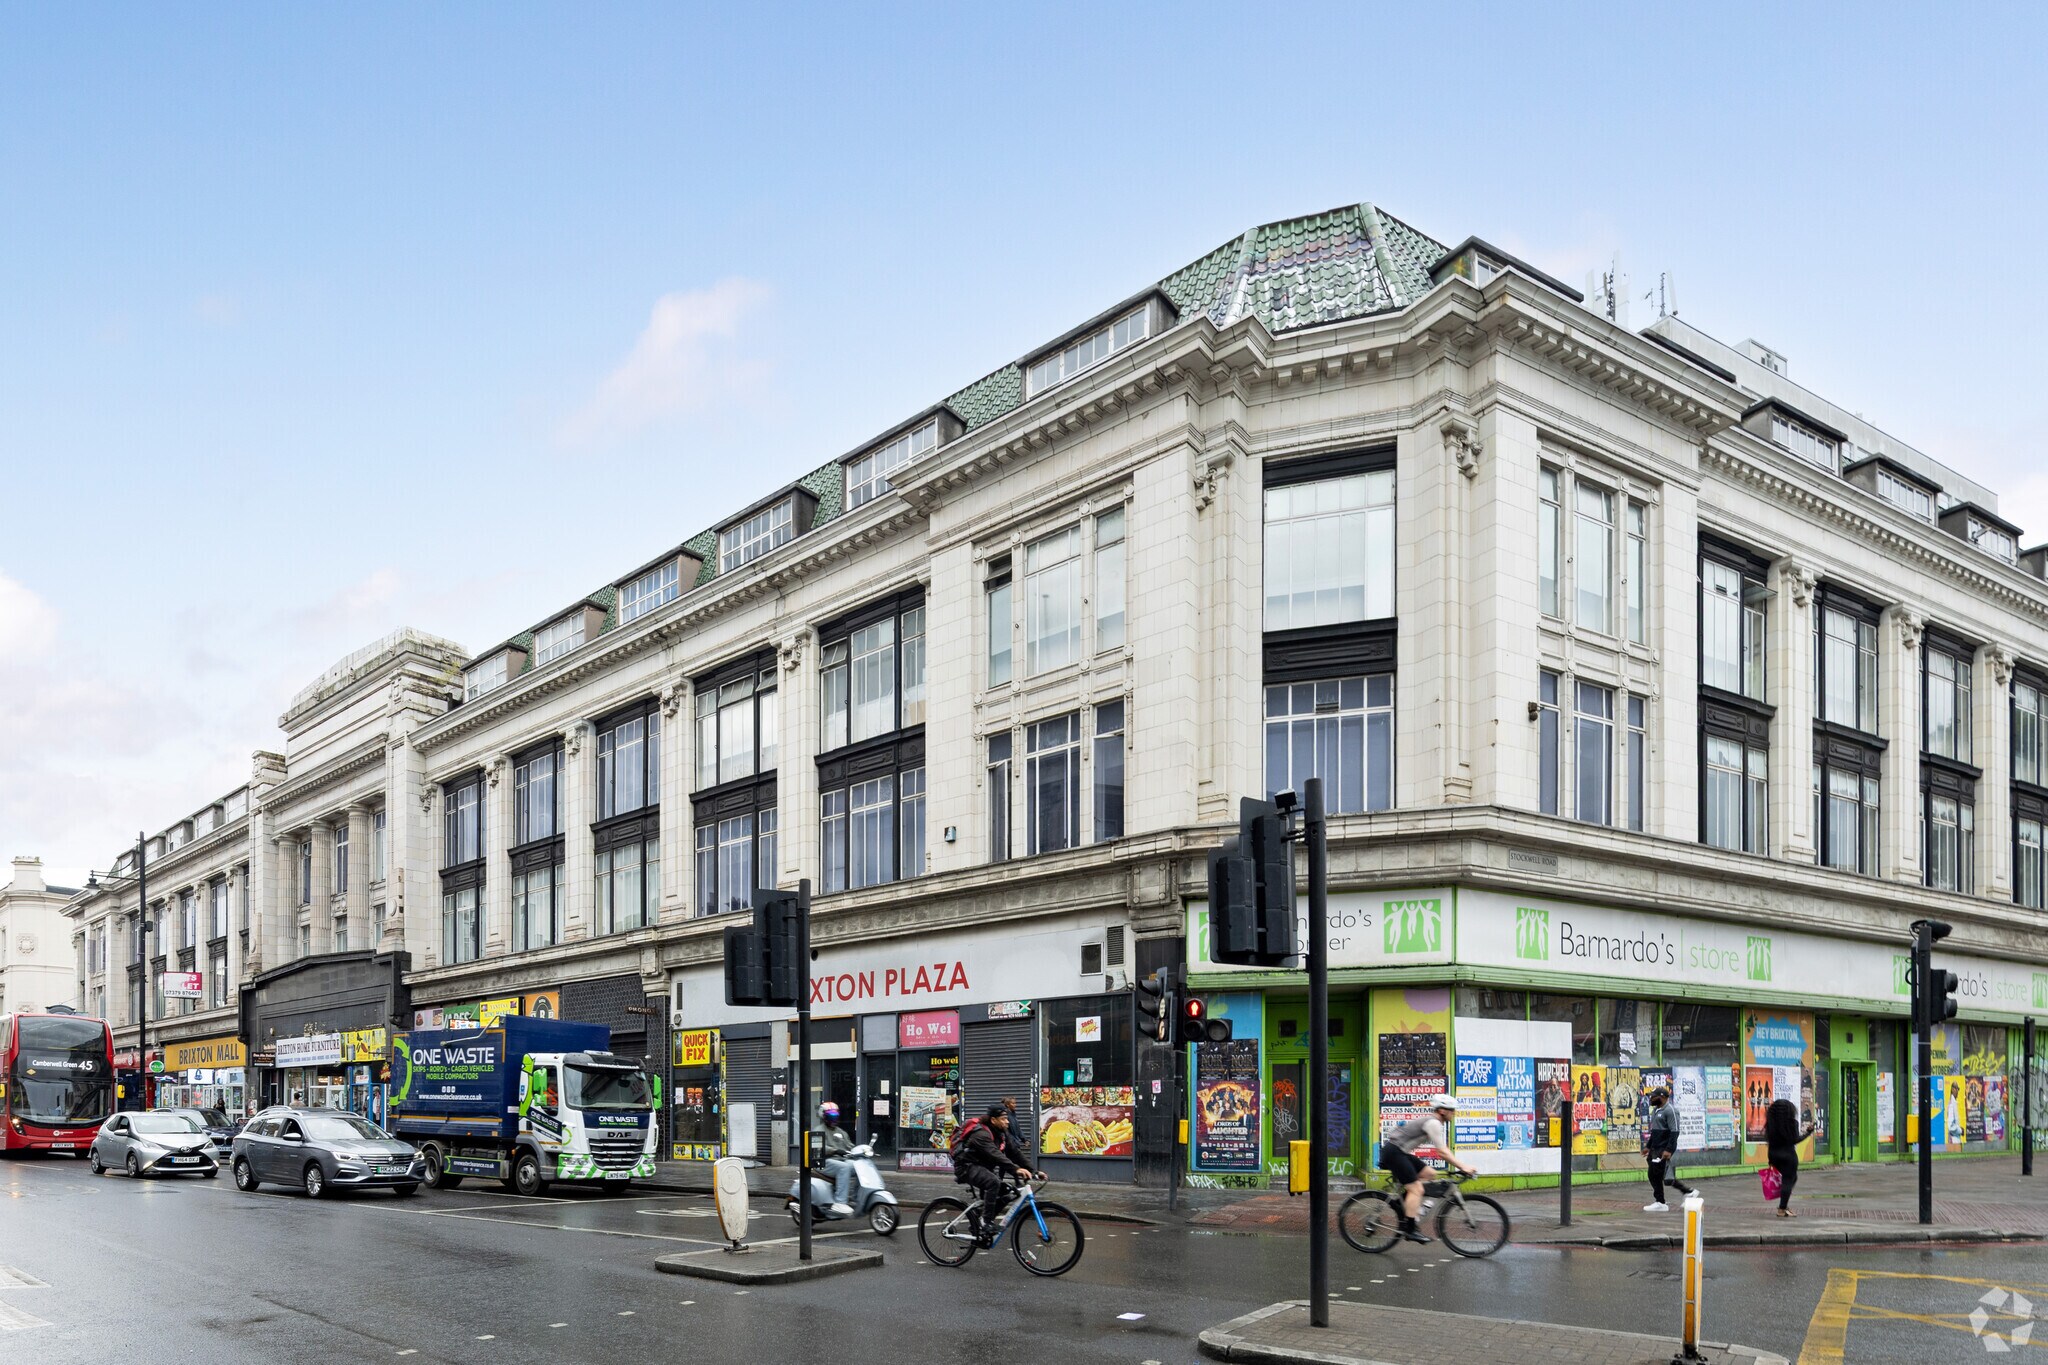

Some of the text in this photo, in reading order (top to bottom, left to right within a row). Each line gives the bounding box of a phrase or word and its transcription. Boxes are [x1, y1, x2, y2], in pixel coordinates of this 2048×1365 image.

[1511, 853, 1556, 866] STOCKWELL ROAD
[1560, 921, 1740, 972] Barnardo's store
[810, 961, 970, 1004] XTON PLAZA
[1997, 978, 2028, 1002] store
[628, 1006, 656, 1014] PHONO
[906, 1022, 951, 1036] Ho Wei
[1756, 1027, 1800, 1042] HEY BRIXTON,
[278, 1044, 296, 1055] BRIXTON
[297, 1042, 310, 1053] HOME
[311, 1039, 340, 1052] FURNITURE
[684, 1033, 708, 1048] QUICK
[179, 1046, 212, 1065] BRIXTON
[216, 1044, 239, 1060] MALL
[413, 1047, 495, 1064] ONE WASTE
[686, 1047, 705, 1060] FIX
[1384, 1050, 1407, 1062] NOIR
[1417, 1049, 1440, 1062] NOIR
[1754, 1046, 1802, 1060] WE'RE MOVING!
[1931, 1050, 1947, 1060] ENING
[32, 1060, 62, 1068] Camberwell
[78, 1061, 93, 1070] 45
[944, 1056, 958, 1064] wei
[1232, 1055, 1253, 1066] NOIR
[1503, 1059, 1526, 1074] ZULU
[1775, 1067, 1786, 1076] LEGAL
[1931, 1065, 1949, 1075] CTOBER
[1463, 1073, 1488, 1084] PLAYS
[1497, 1075, 1532, 1090] NATION
[1646, 1075, 1667, 1086] R&B
[1708, 1074, 1730, 1084] SUMMER
[1775, 1076, 1786, 1084] WEED
[1774, 1084, 1793, 1093] STRAIGHT
[531, 1111, 559, 1128] ONE WASTE
